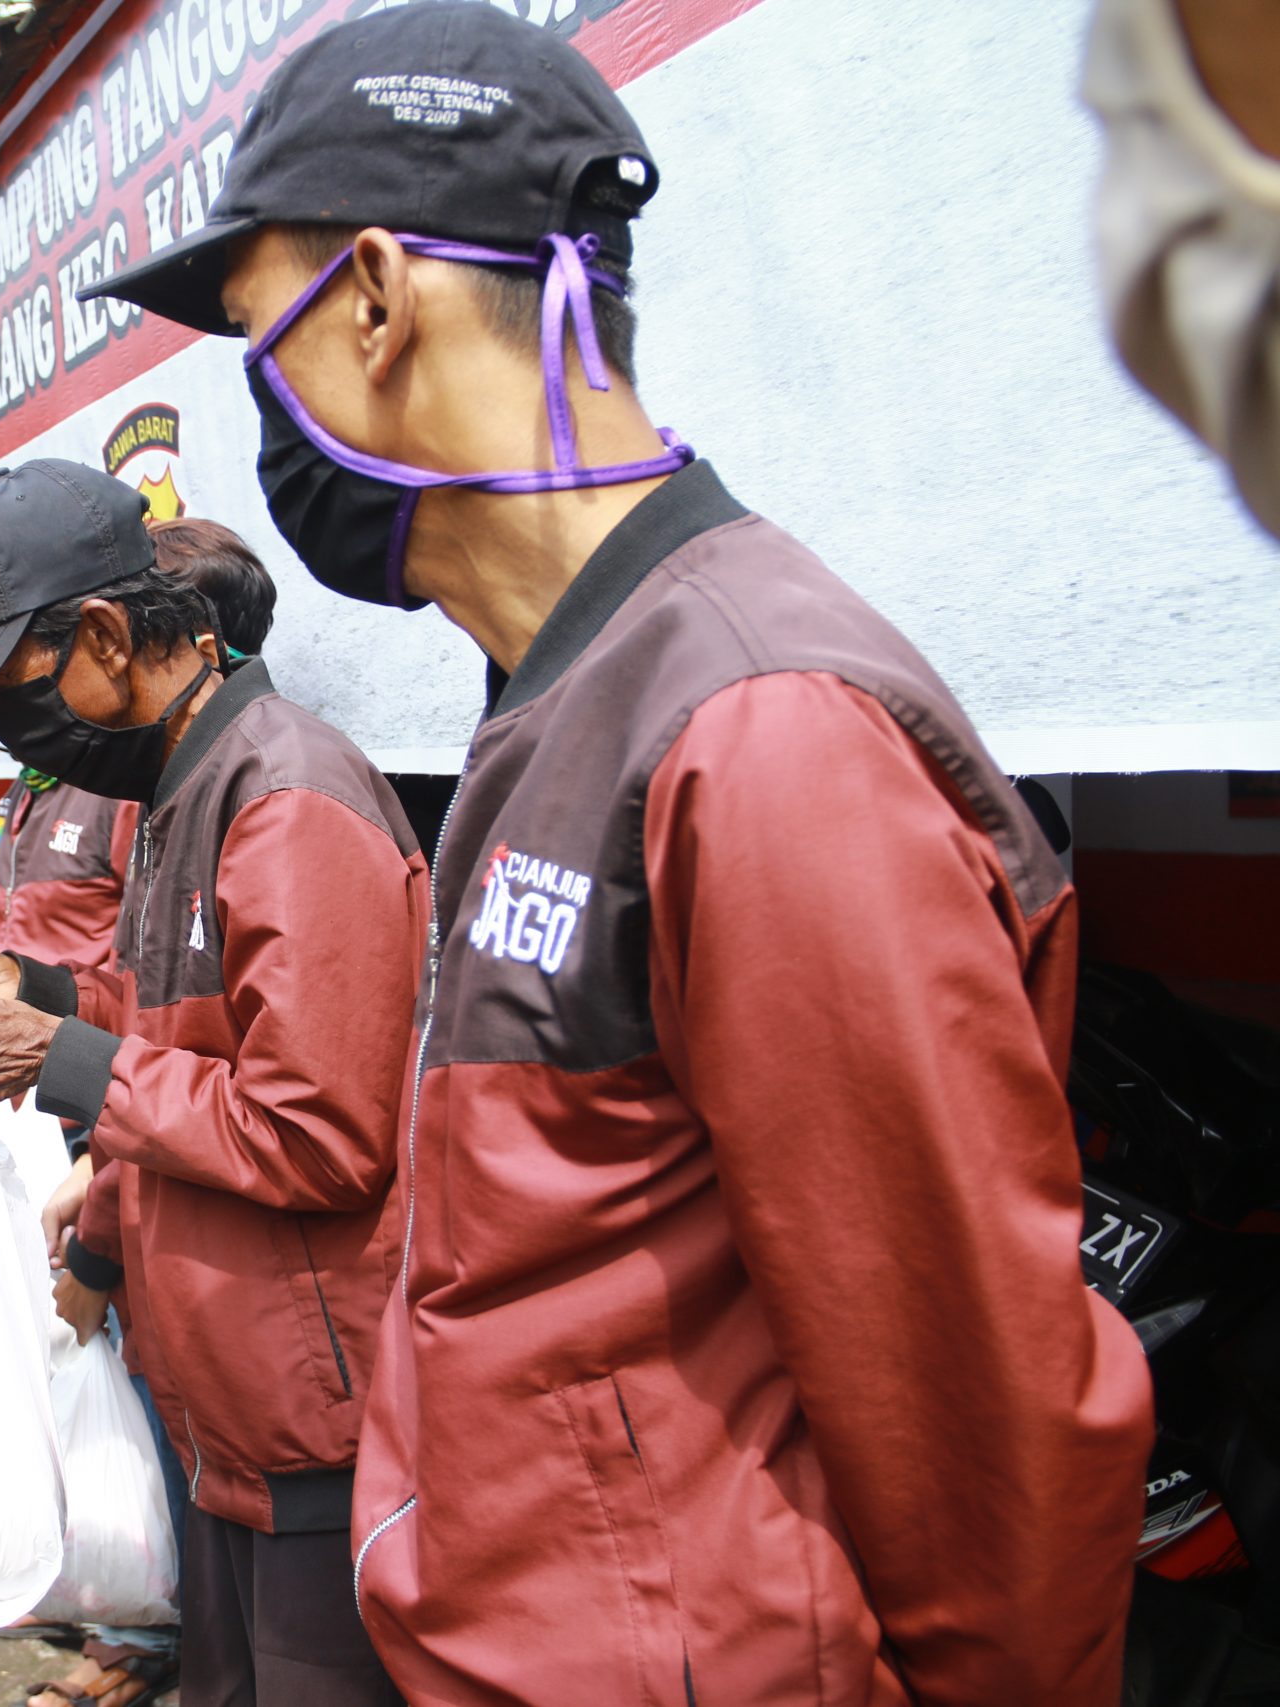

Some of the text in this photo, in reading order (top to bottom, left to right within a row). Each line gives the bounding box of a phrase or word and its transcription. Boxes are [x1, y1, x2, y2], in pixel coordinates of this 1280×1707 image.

[352, 75, 513, 106] PROYEK GERBANG TOL
[368, 90, 495, 115] KARANG TENGAH
[393, 106, 461, 125] DES 2003
[108, 415, 176, 472] JAWA BARAT
[469, 851, 592, 974] CIANJUR JAGO
[1078, 1212, 1147, 1270] ZX
